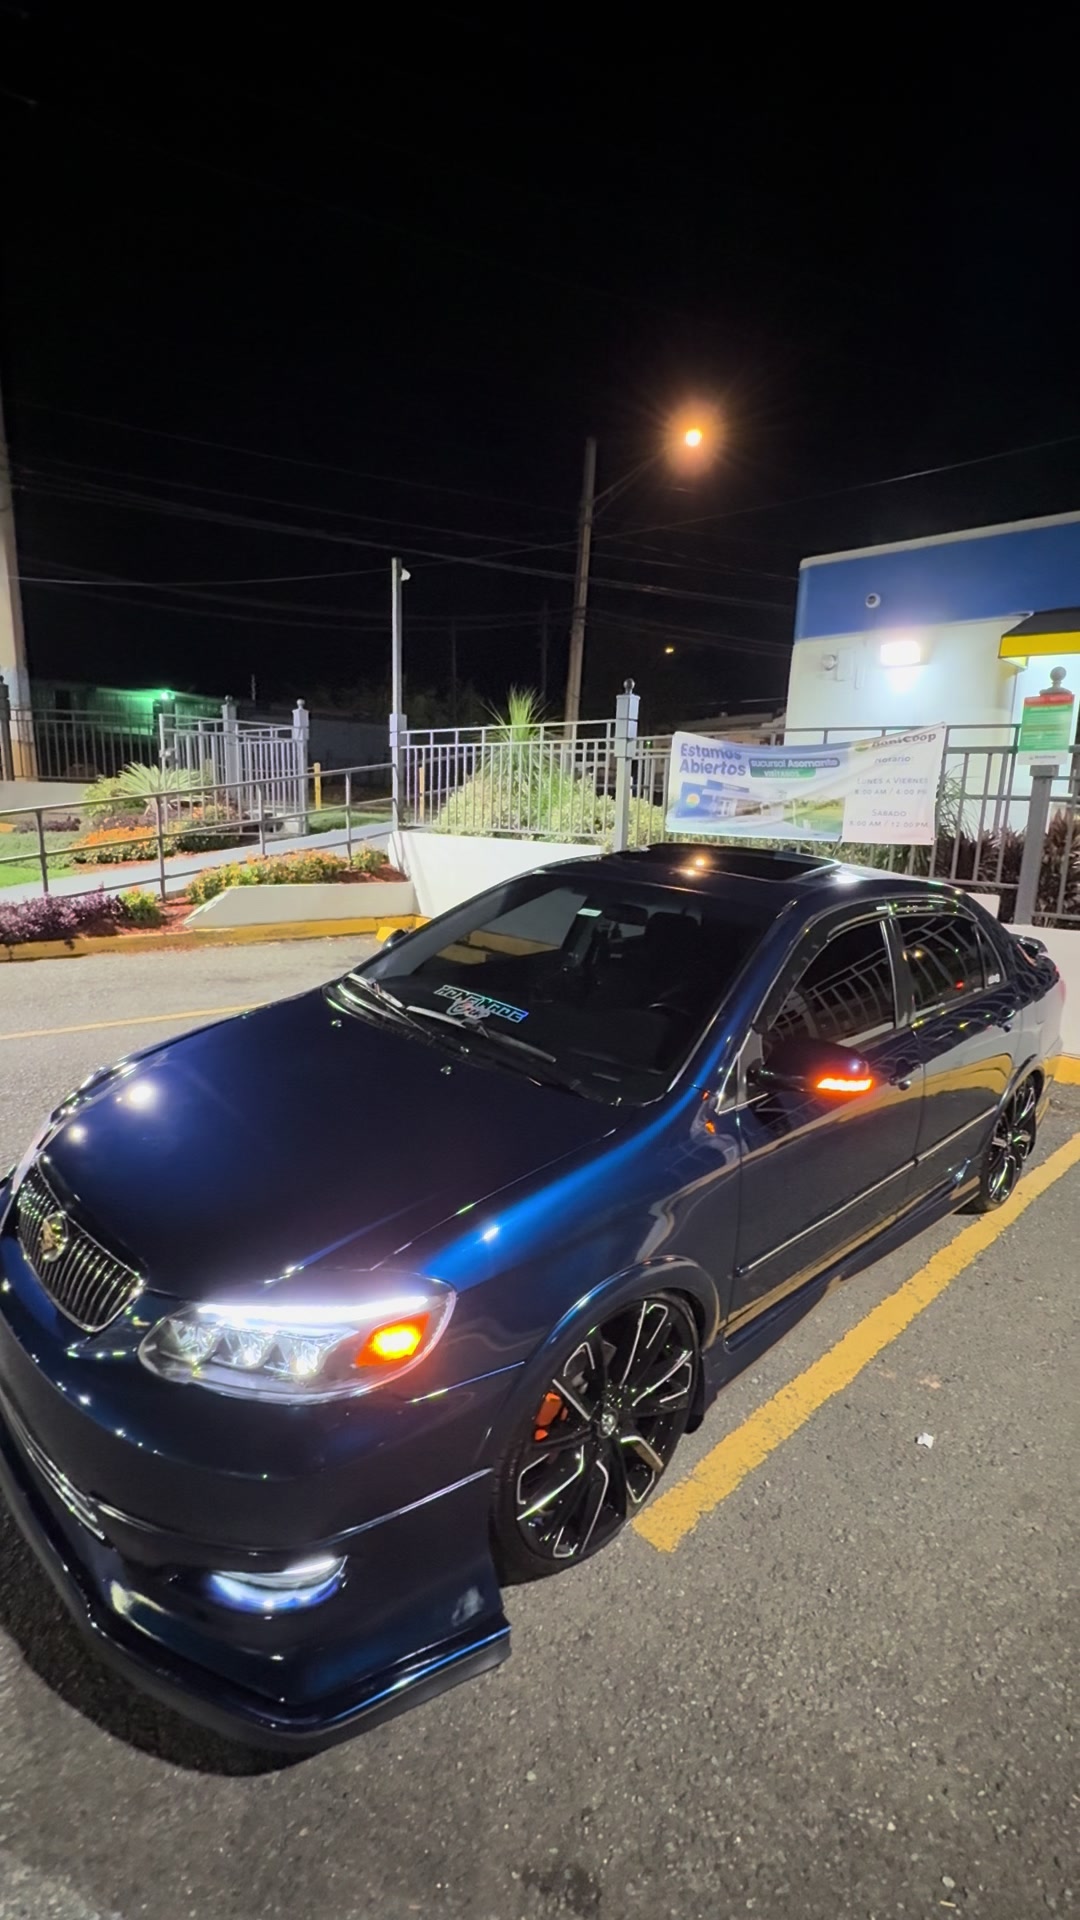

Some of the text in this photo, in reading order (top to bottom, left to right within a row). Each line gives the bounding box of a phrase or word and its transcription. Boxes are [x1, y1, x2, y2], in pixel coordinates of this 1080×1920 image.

[681, 743, 742, 760] Estamos
[679, 759, 746, 776] Abiertos
[787, 759, 837, 768] Asomante
